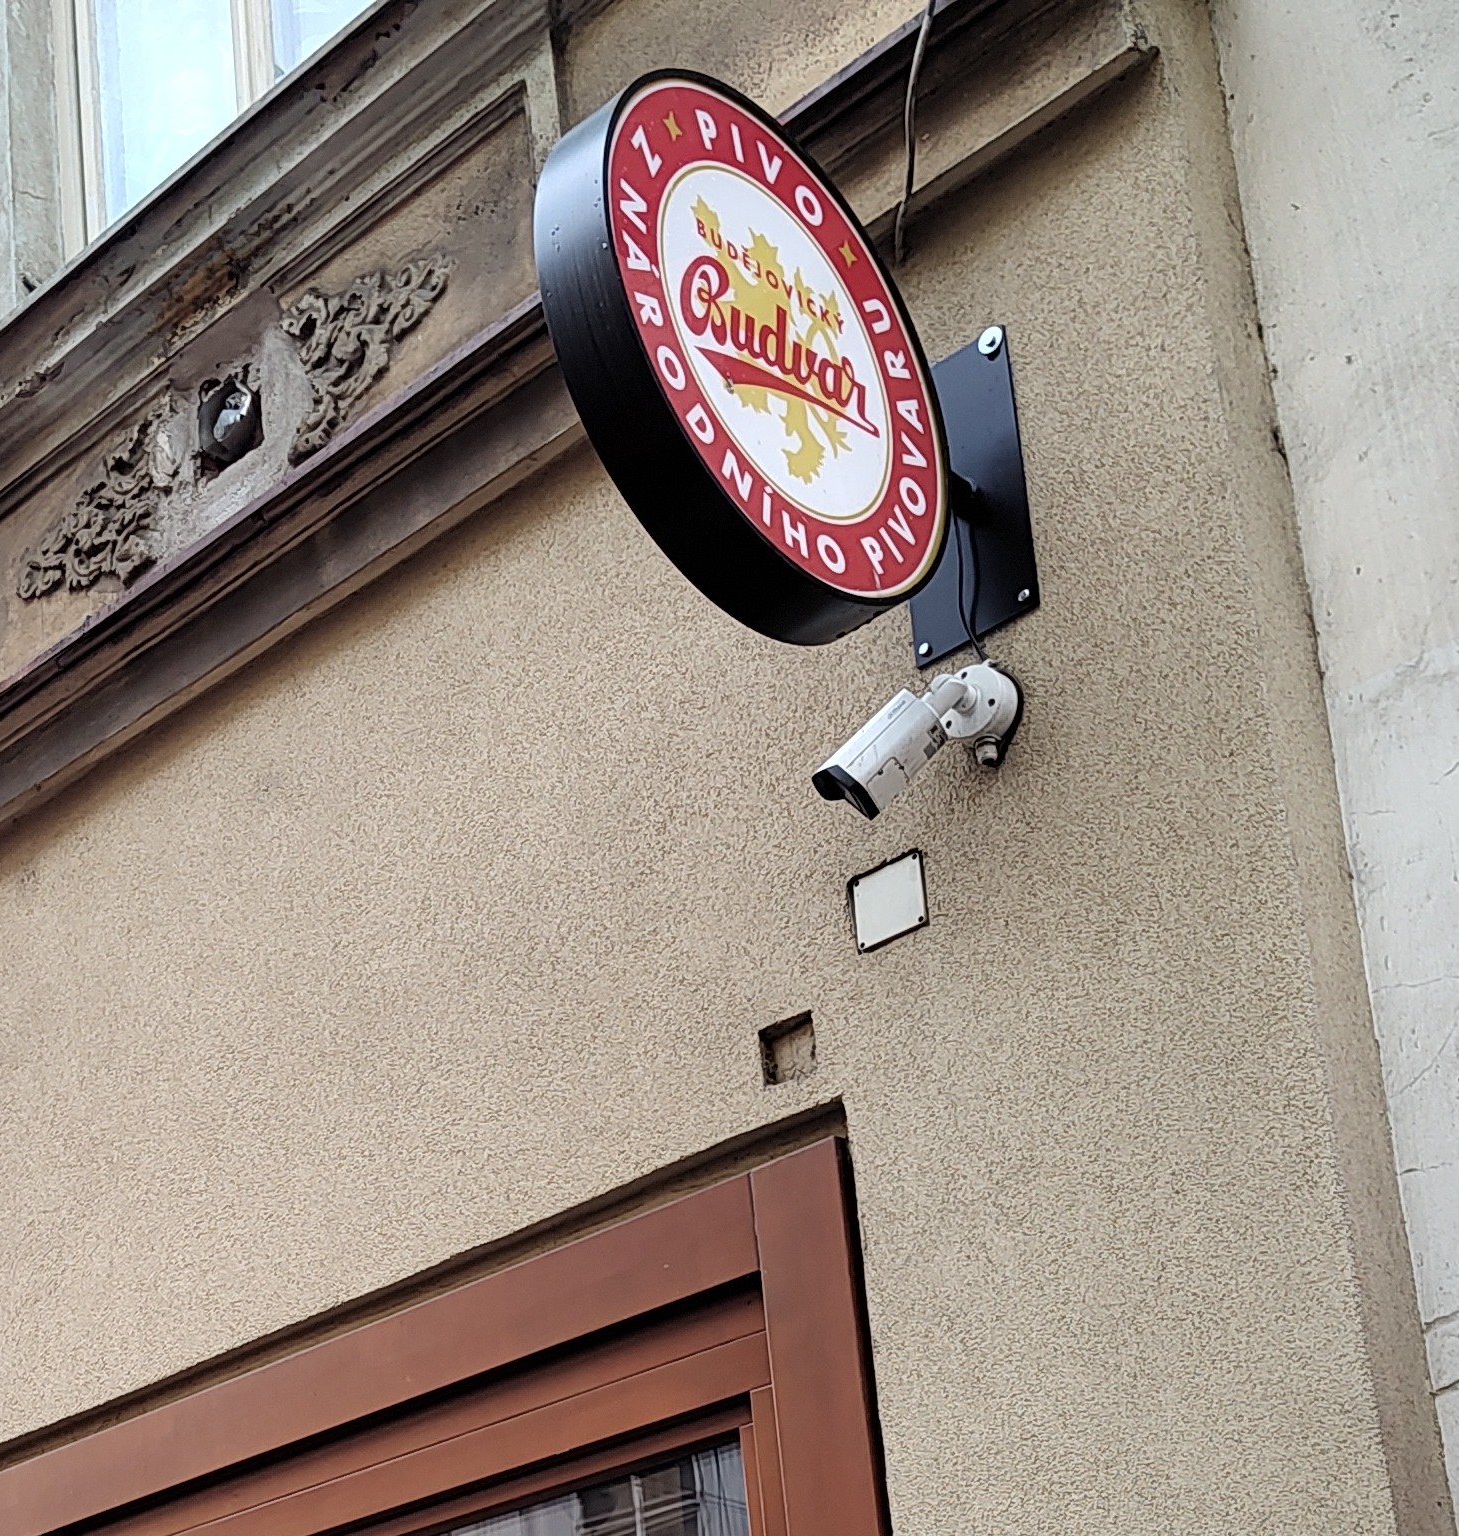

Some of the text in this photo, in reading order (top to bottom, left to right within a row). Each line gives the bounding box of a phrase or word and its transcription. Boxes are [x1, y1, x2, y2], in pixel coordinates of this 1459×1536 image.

[695, 107, 826, 228] PIVO
[618, 124, 933, 576] Z NÁRODNÍHO PIVOVARU
[680, 254, 880, 434] Budvar
[694, 217, 846, 336] BUDĚJOVICKÝ
